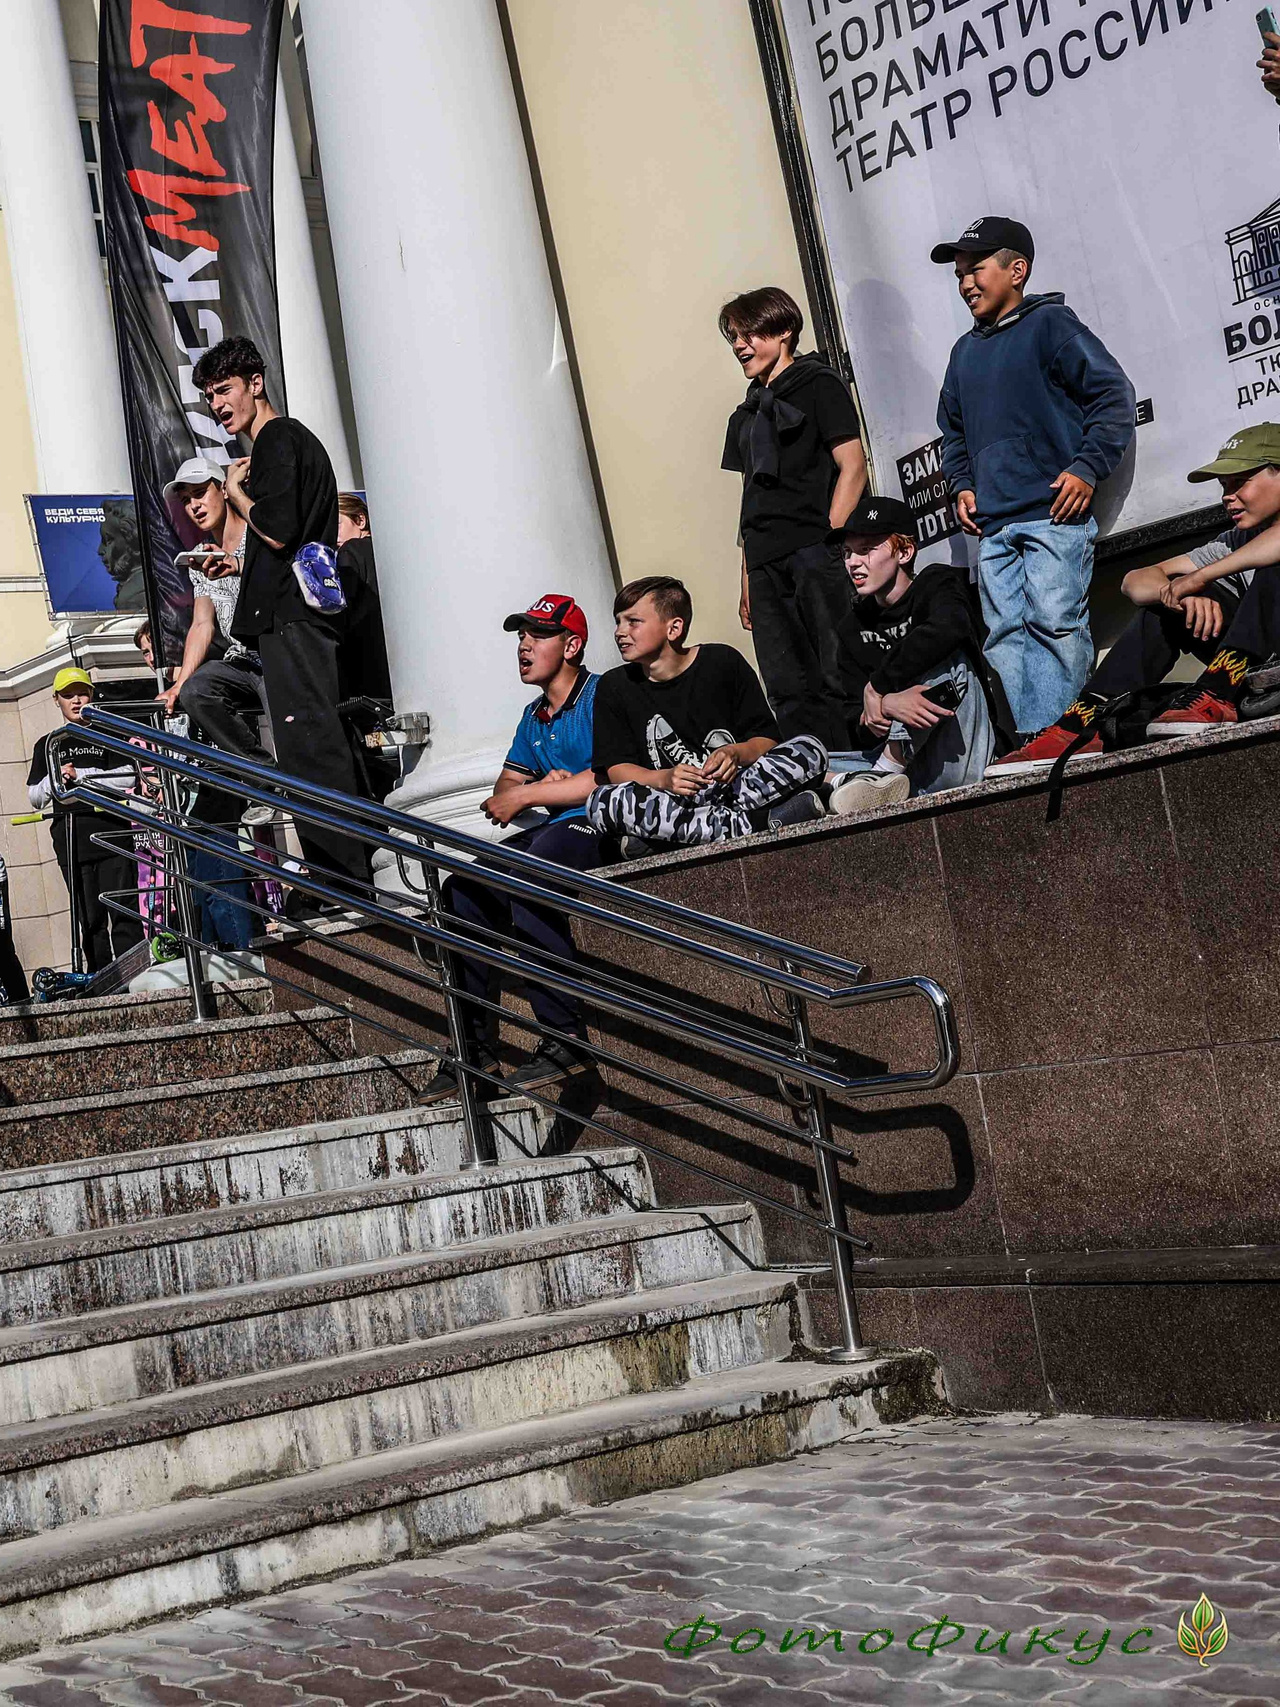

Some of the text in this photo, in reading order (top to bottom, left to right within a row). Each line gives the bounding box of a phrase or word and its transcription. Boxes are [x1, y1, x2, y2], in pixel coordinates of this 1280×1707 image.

[815, 0, 970, 82] БОЛЬ
[828, 0, 1087, 149] ДРАМАТИ
[836, 88, 972, 193] ТЕАТР
[1223, 309, 1280, 356] БО
[1237, 375, 1280, 410] ДРА
[902, 444, 943, 486] ЗАЙ
[44, 507, 105, 516] ВЕДИ СЕБЯ
[908, 488, 932, 509] ИЛИ
[46, 515, 106, 523] КУЛЬТУРНО
[69, 746, 104, 757] Monday
